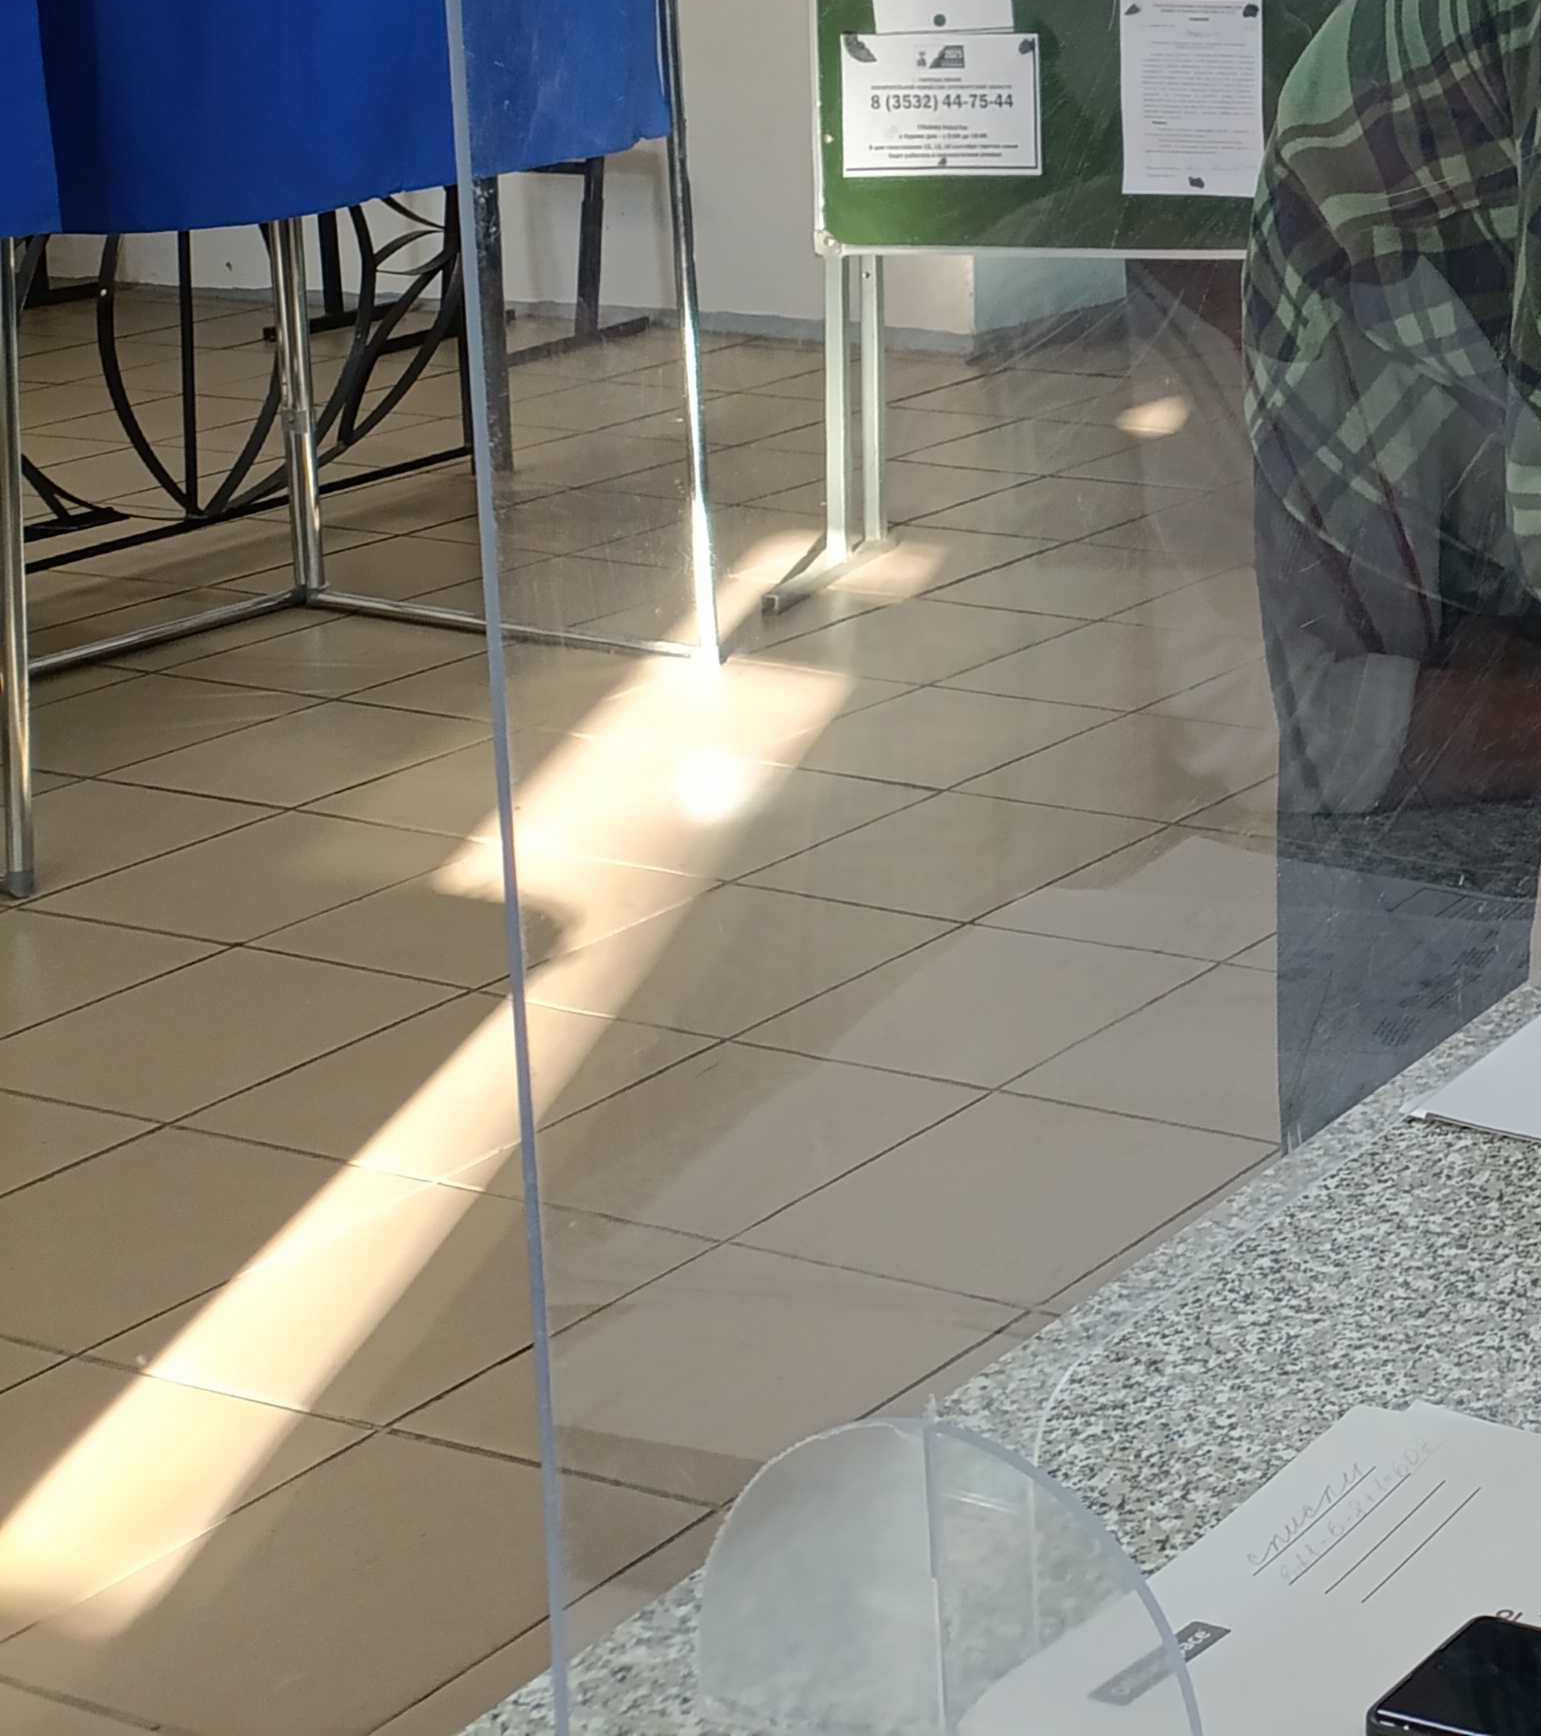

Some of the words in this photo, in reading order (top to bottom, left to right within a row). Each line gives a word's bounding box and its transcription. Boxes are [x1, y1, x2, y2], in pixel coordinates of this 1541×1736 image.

[871, 95, 881, 109] 8
[886, 94, 938, 111] (3532)
[943, 93, 1014, 108] 44-75-44
